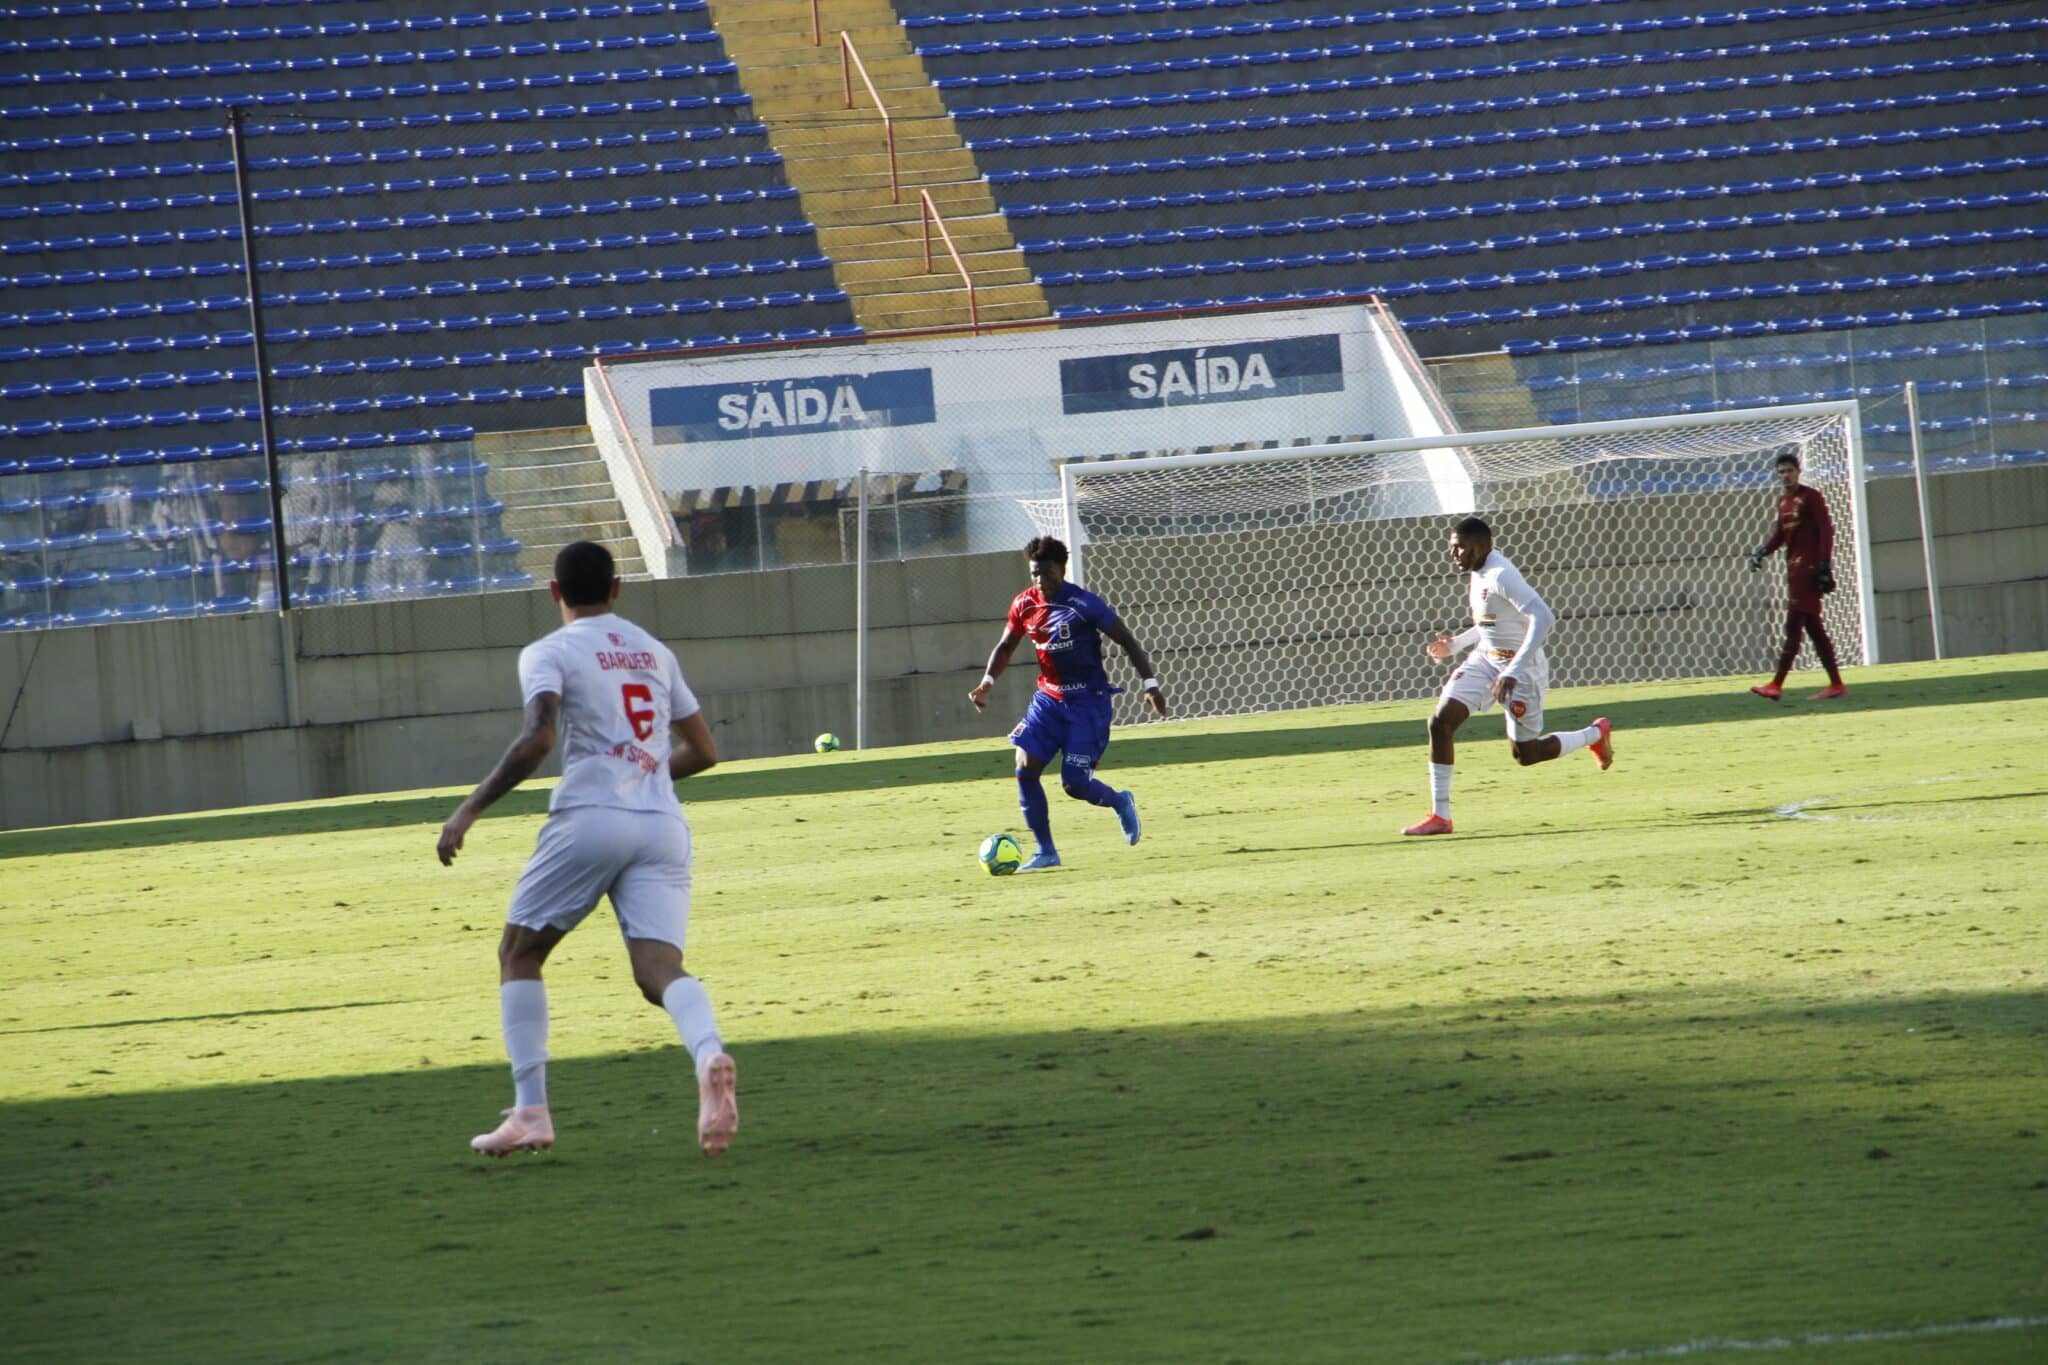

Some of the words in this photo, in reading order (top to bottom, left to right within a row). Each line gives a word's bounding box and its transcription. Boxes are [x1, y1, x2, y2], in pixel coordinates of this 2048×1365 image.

[1128, 348, 1276, 400] SAÍDA
[717, 381, 867, 431] SAÍDA
[621, 683, 655, 742] 6
